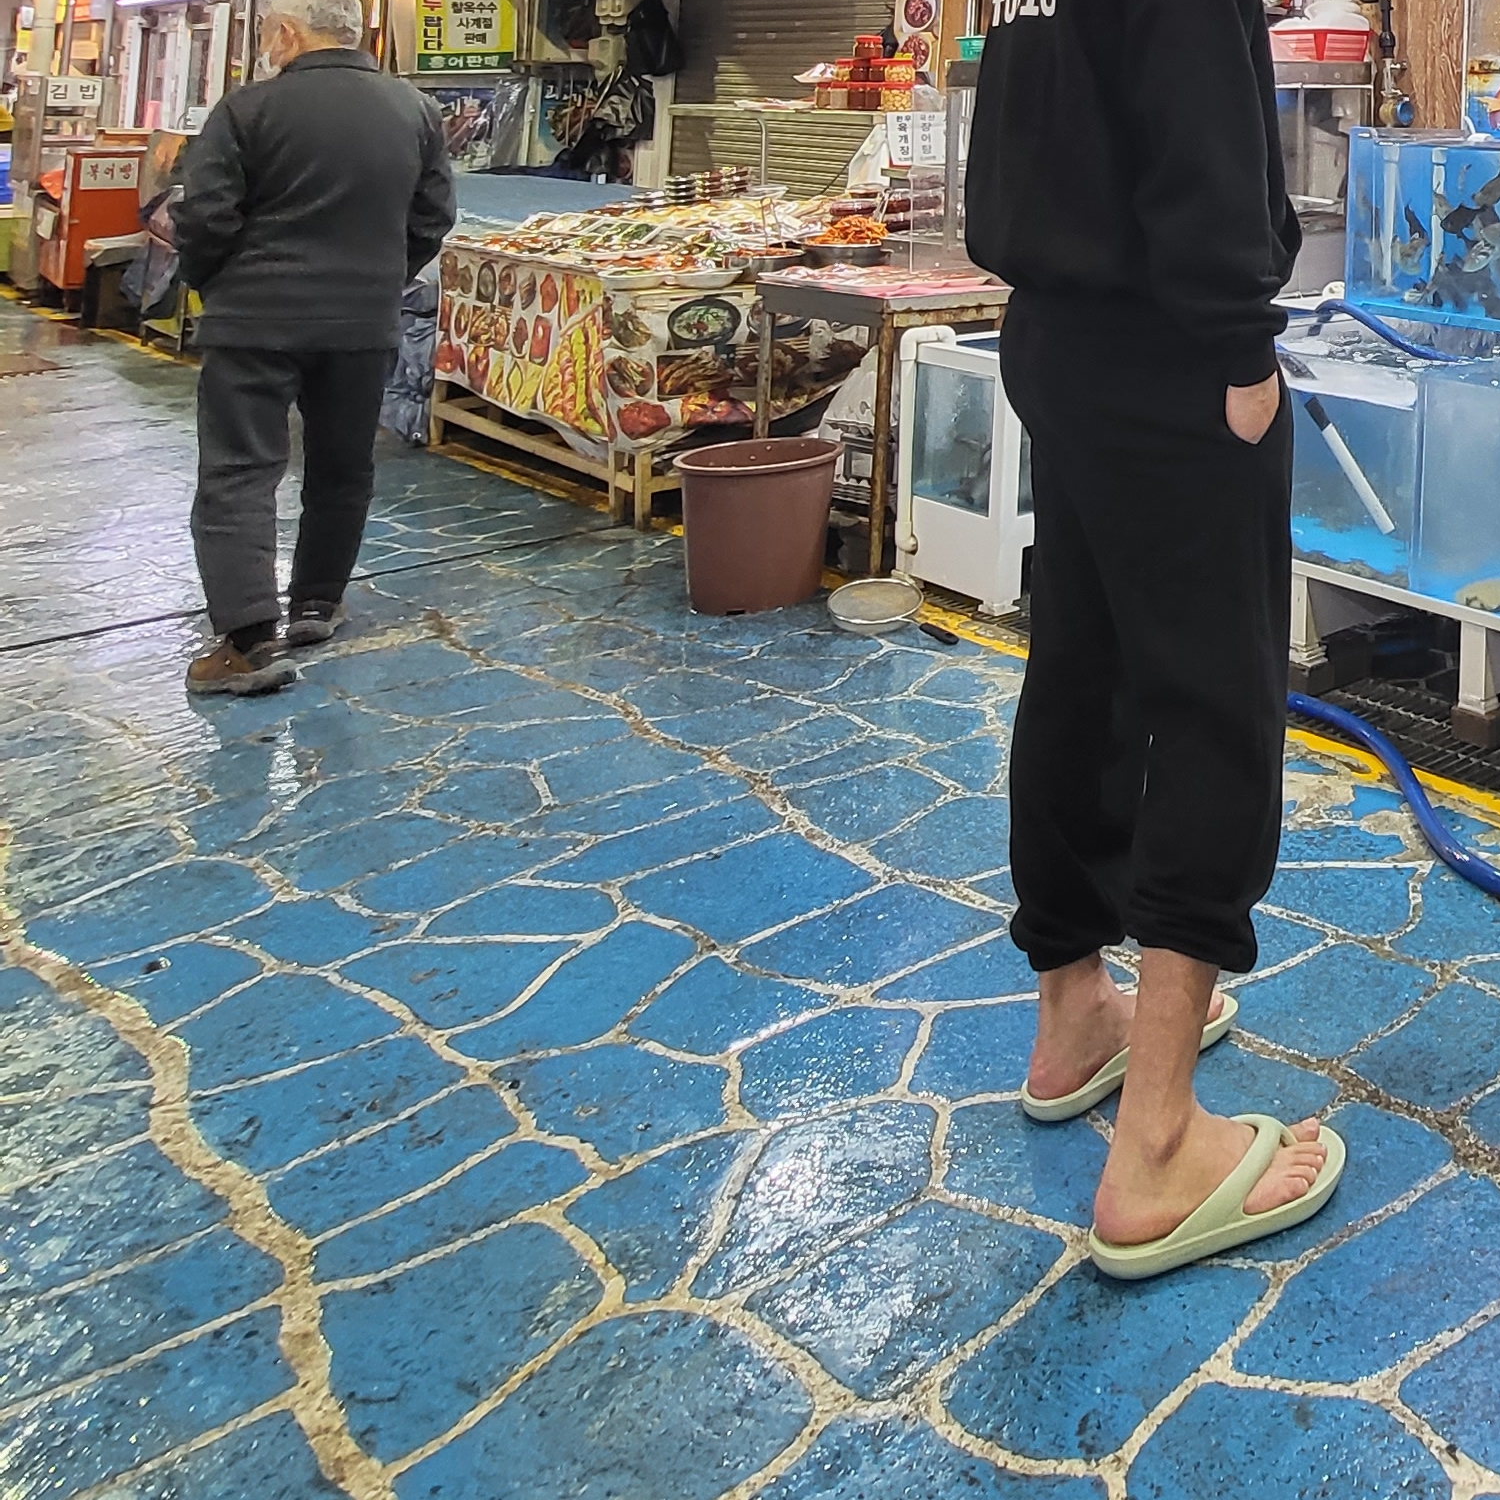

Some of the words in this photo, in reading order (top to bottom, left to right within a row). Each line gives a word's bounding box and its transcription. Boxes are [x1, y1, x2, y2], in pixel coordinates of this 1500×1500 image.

[451, 1, 498, 14] 찰옥수수
[464, 32, 487, 44] 판매
[897, 123, 910, 155] 육개장
[921, 122, 932, 154] 장어탕
